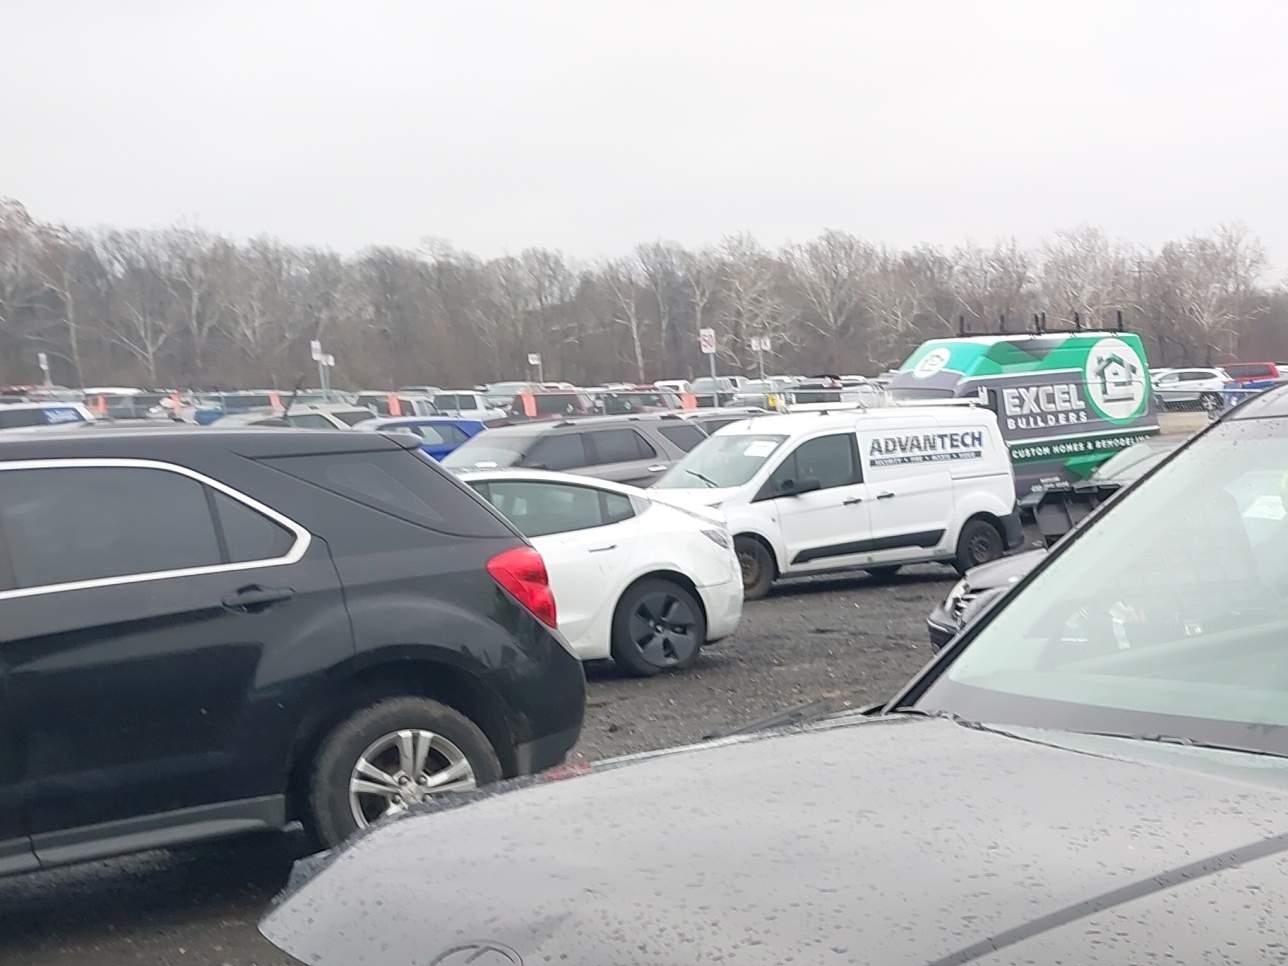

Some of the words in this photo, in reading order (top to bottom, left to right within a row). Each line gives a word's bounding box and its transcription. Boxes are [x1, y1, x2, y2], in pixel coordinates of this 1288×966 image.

[1003, 384, 1086, 416] EXCEL
[1007, 411, 1088, 430] BUILDERS
[869, 431, 982, 457] ADVANTECH
[1012, 446, 1050, 459] CUSTOM
[1052, 441, 1085, 454] HOMES
